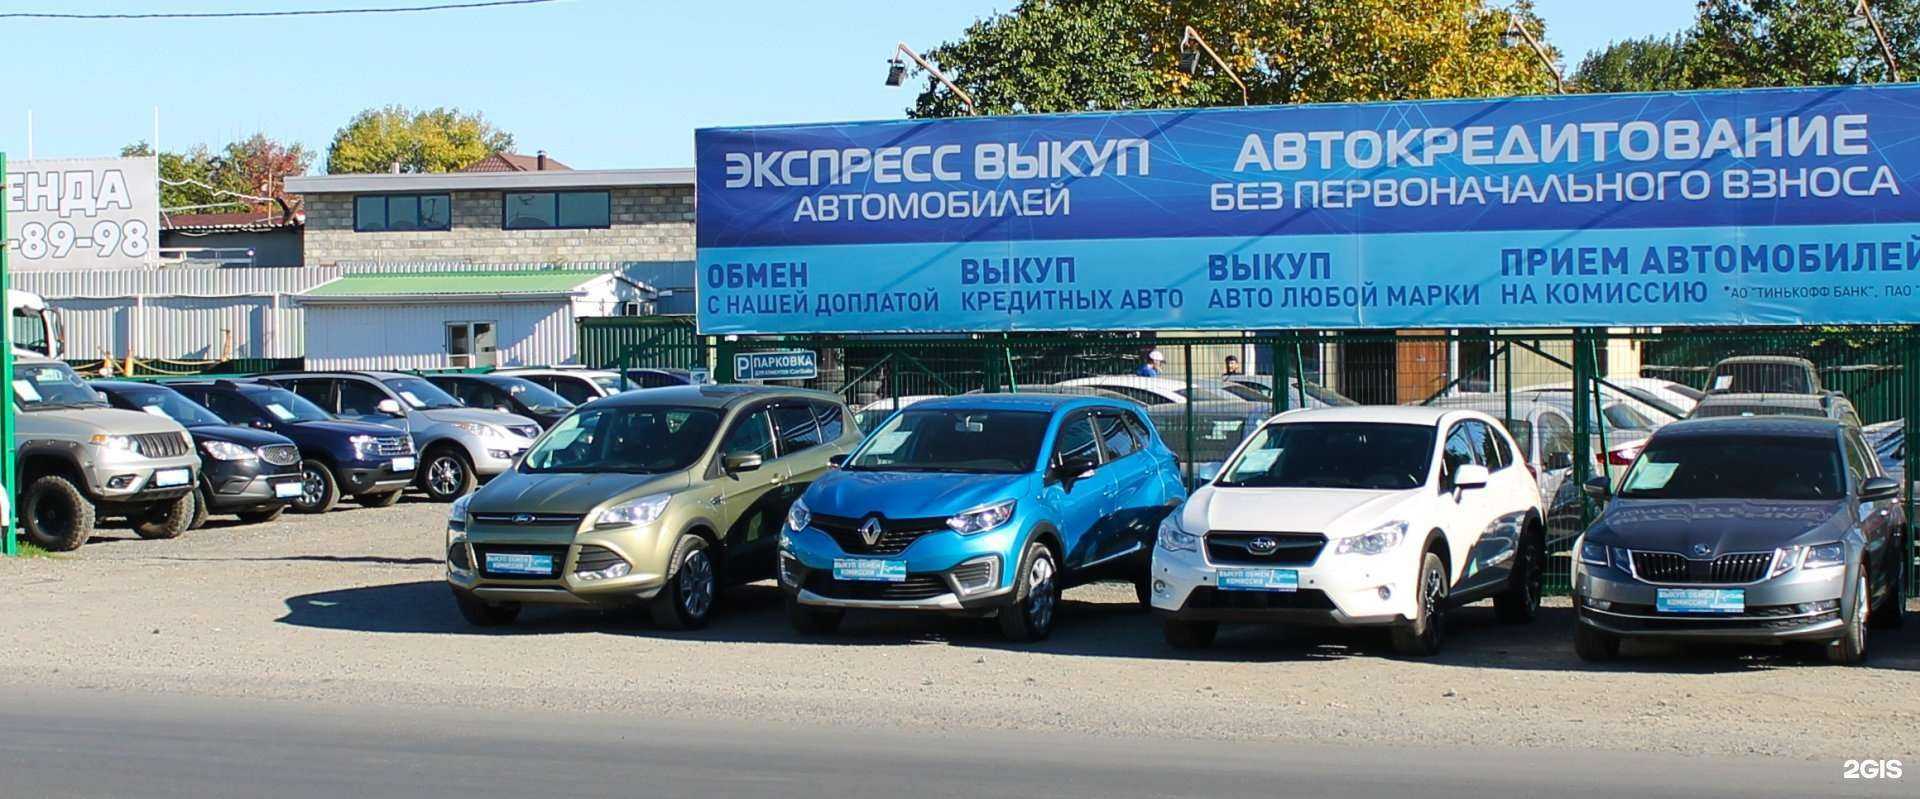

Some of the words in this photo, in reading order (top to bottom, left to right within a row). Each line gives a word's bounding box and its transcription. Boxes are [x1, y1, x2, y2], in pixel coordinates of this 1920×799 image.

[1233, 114, 1869, 173] АВТОКРЕДИТОВАНИЕ
[725, 145, 961, 188] ЭКСПРЕСС
[974, 138, 1150, 181] ВЫКУП
[792, 182, 1071, 223] АВТОМОБИЛЕЙ
[1210, 182, 1284, 212] БЕЗ
[1293, 169, 1712, 210] ПЕРВОНАЧАЛЬНОГО
[1721, 164, 1901, 200] ВЗНОСА
[1207, 252, 1331, 282] ВЫКУП
[1500, 246, 1629, 277] ПРИЕМ
[1640, 233, 1920, 276] АВТОМОБИЛЕЙ
[706, 262, 808, 289] ОБМЕН
[960, 256, 1076, 285] ВЫКУП
[707, 295, 720, 315] С
[726, 289, 809, 315] НАШЕЙ
[814, 287, 940, 318] ДОПЛАТОЙ
[961, 289, 1114, 314] КРЕДИТНЫХ
[1120, 288, 1184, 310] АВТО
[1207, 288, 1274, 309] АВТО
[1281, 281, 1378, 308] ЛЮБОЙ
[1387, 284, 1481, 307] МАРКИ
[1501, 284, 1539, 305] НА
[1546, 281, 1709, 305] КОМИССИЮ
[1751, 286, 1830, 298] "ТИНЬКОФФ
[1884, 284, 1912, 297] ПАО
[753, 355, 814, 369] ПАРКОВКА
